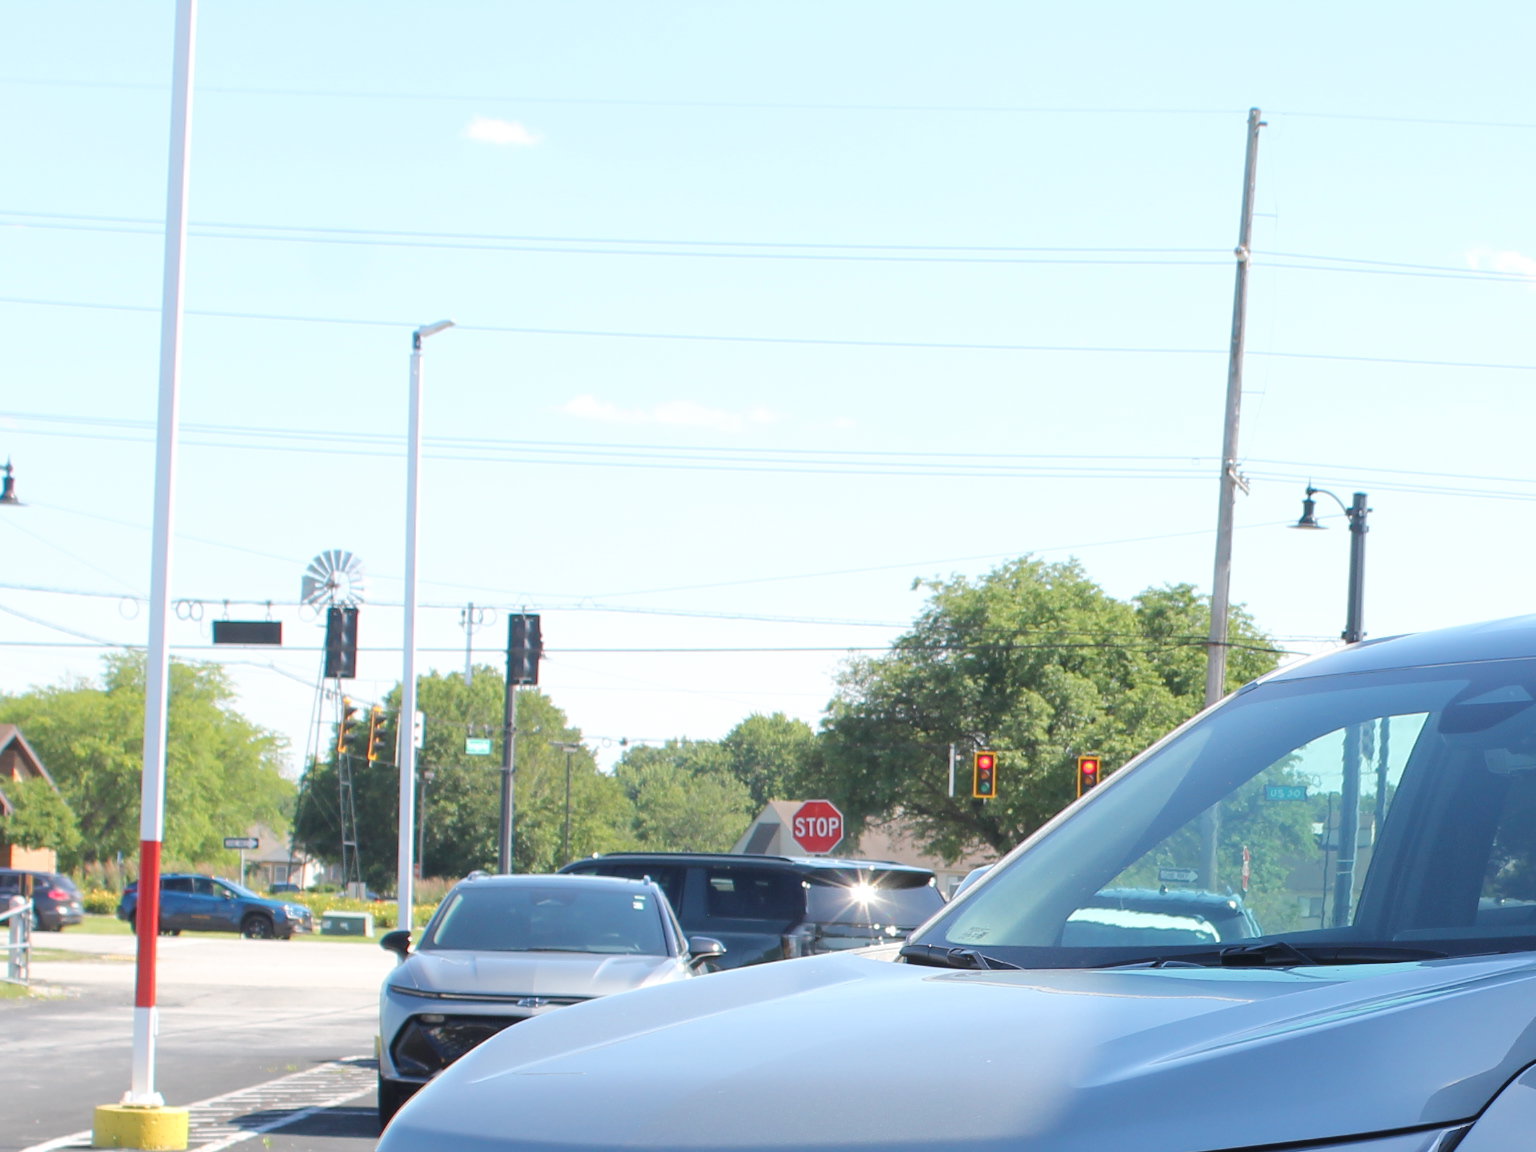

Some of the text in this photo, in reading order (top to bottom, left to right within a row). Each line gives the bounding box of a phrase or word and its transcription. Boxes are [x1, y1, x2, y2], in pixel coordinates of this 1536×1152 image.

[1270, 789, 1301, 798] US 30
[795, 817, 839, 838] STOP
